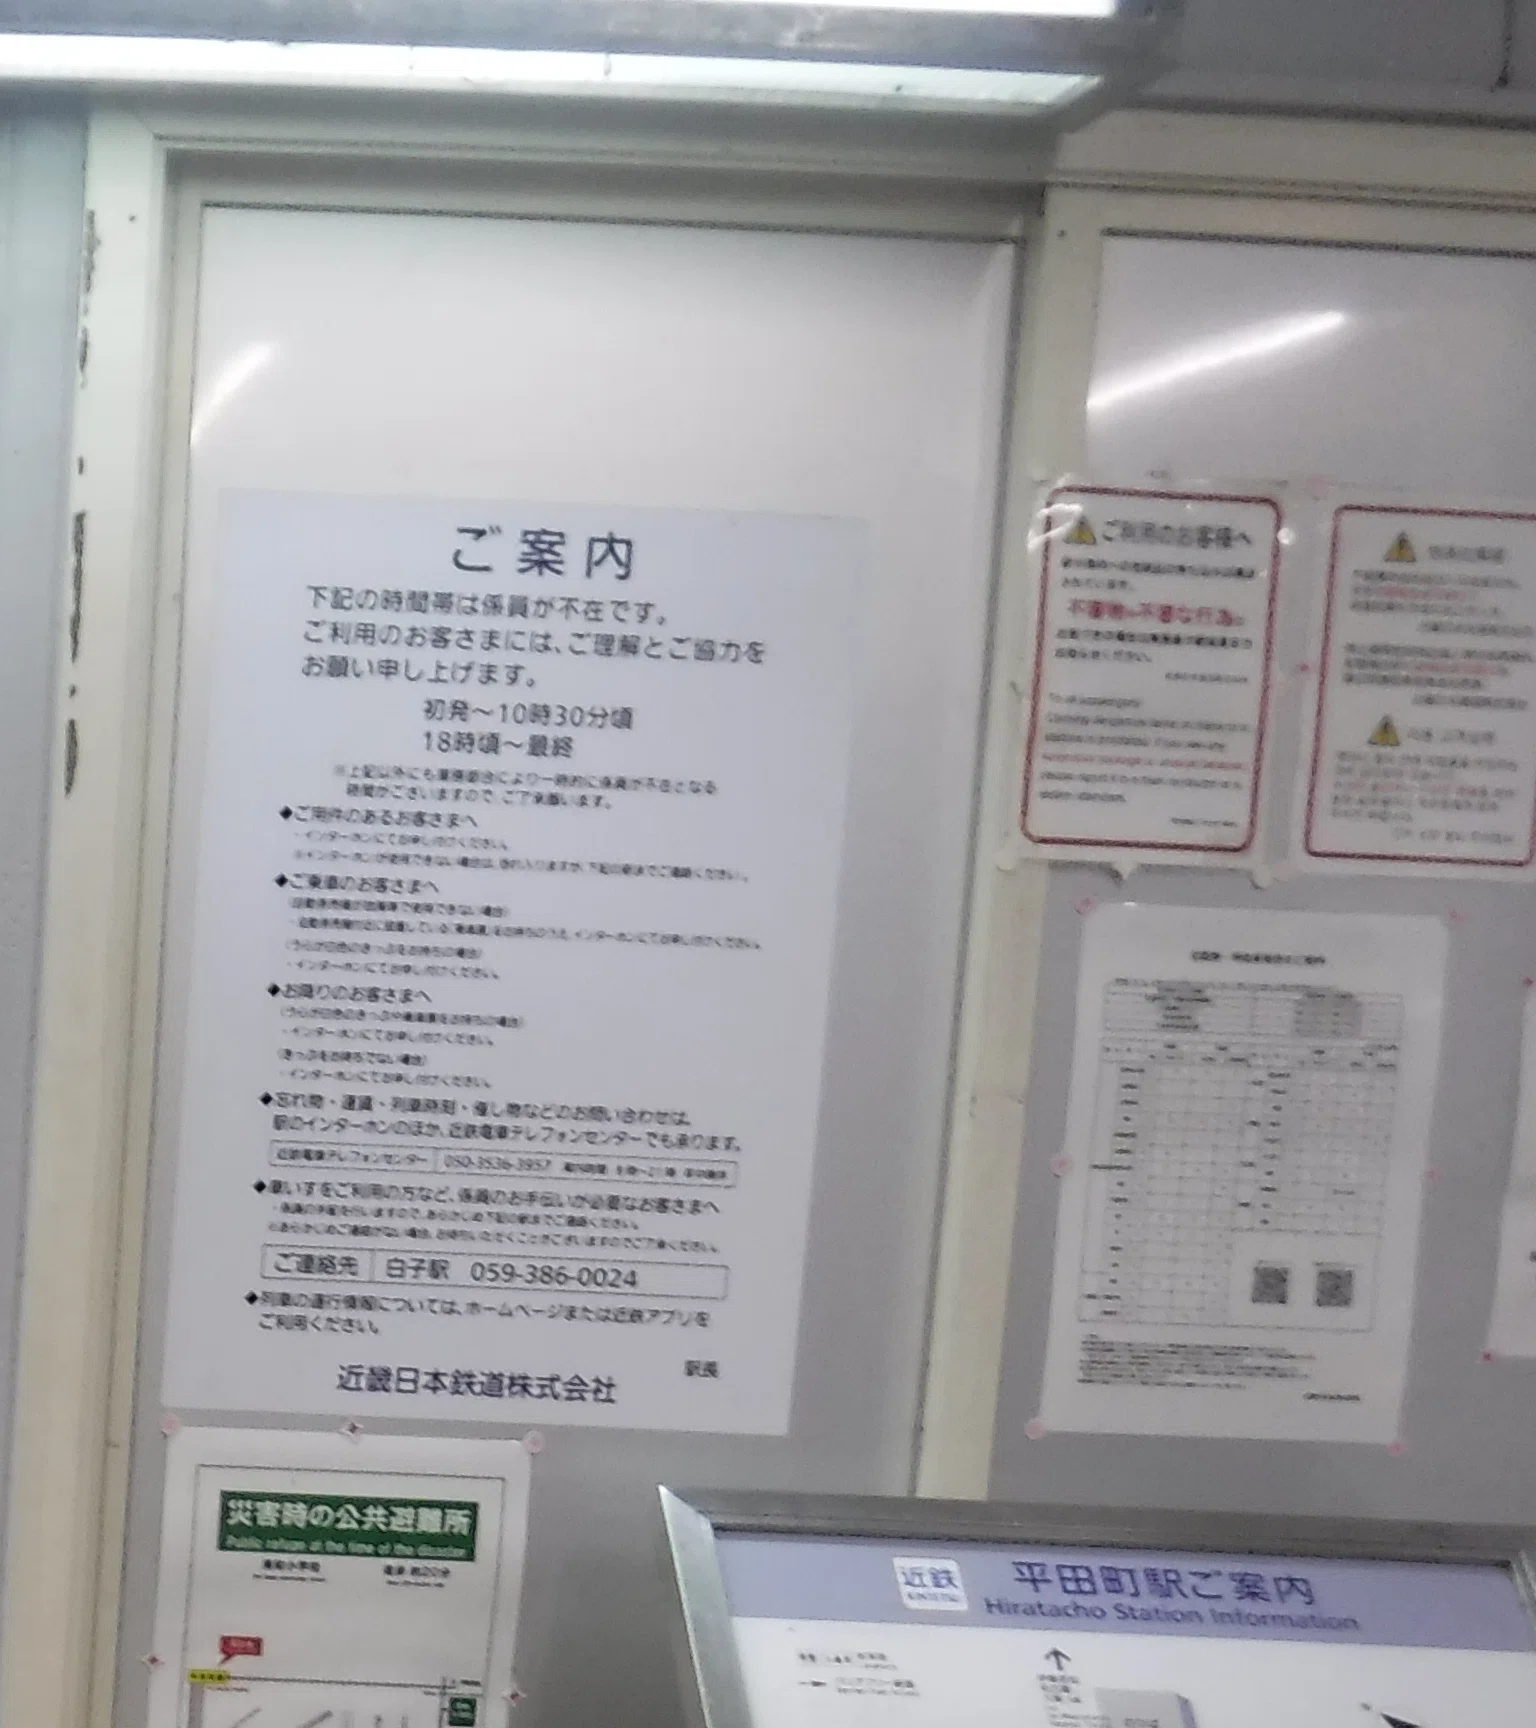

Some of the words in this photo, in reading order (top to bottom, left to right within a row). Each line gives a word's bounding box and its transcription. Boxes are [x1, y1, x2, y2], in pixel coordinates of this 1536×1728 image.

[452, 525, 634, 581] ご案内
[307, 584, 667, 627] 下記の時間帯は係員が不在です。
[303, 620, 766, 666] ご利用のお客さまには、ご理解とご協力を
[301, 654, 537, 689] お願い申し上げます。
[274, 1251, 359, 1277] ご連絡先
[385, 1257, 450, 1280] 白子駅
[470, 1260, 637, 1288] 059-386-0024
[335, 1363, 618, 1404] 近畿日本鉄道株式会社
[226, 1499, 473, 1536] 災害時の公共避難所
[900, 1566, 960, 1590] 近鉄
[1012, 1560, 1316, 1605] 平田町駅ご案内
[984, 1597, 1108, 1621] Hiratacho
[1114, 1602, 1204, 1624] Station
[1209, 1607, 1360, 1631] Information
